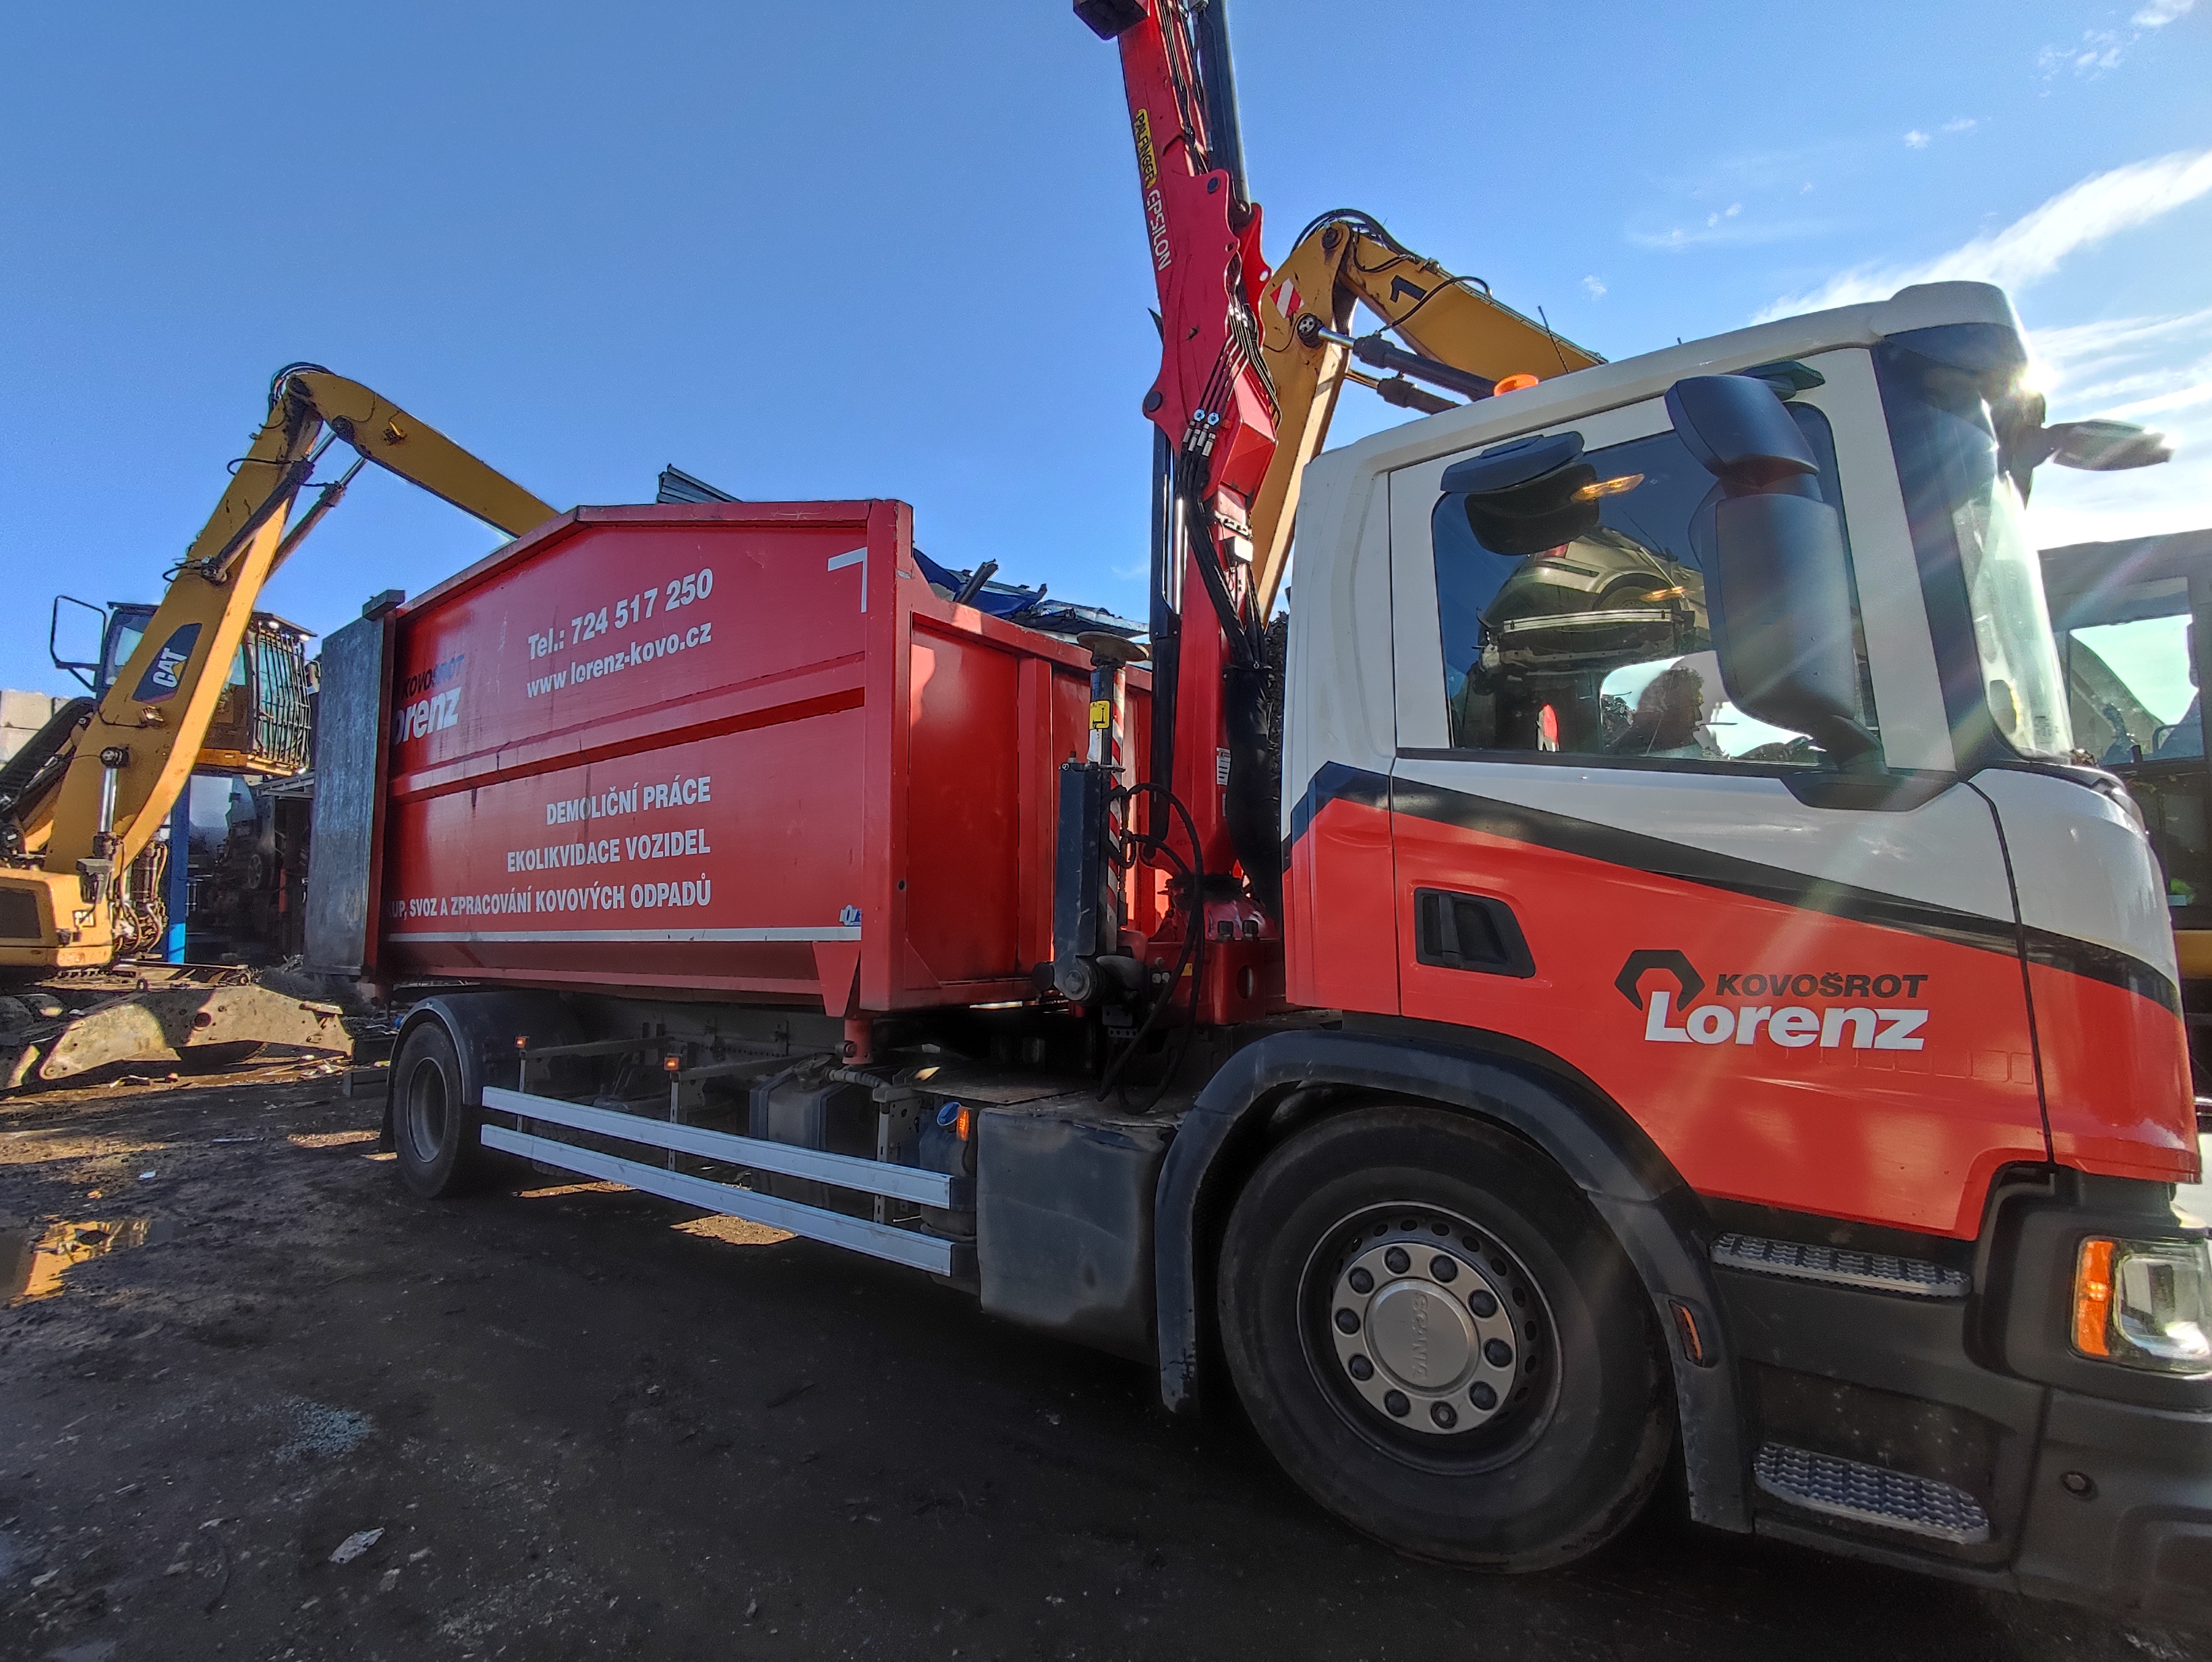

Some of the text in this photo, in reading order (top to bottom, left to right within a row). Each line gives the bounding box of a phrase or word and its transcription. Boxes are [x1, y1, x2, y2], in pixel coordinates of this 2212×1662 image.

[1135, 111, 1172, 271] PALFINGER EPSILON
[528, 568, 713, 660] Tel.: 724 517 250
[152, 647, 188, 688] CAT
[571, 622, 711, 685] lorenz-kovo.cz
[390, 686, 461, 745] orenz
[546, 774, 711, 825] DEMOLIČNÍ PRÁCE
[507, 828, 711, 872] EKOLIKVIDACE VOZIDEL
[409, 897, 438, 917] SVOZ
[440, 897, 448, 916] A
[450, 885, 532, 915] ZPRACOVÁNÍ
[535, 881, 625, 913] KOVOVÝCH
[631, 872, 711, 909] ODPADŮ
[1715, 971, 1929, 998] KOVOŠROT
[1644, 990, 1929, 1051] Lorenz
